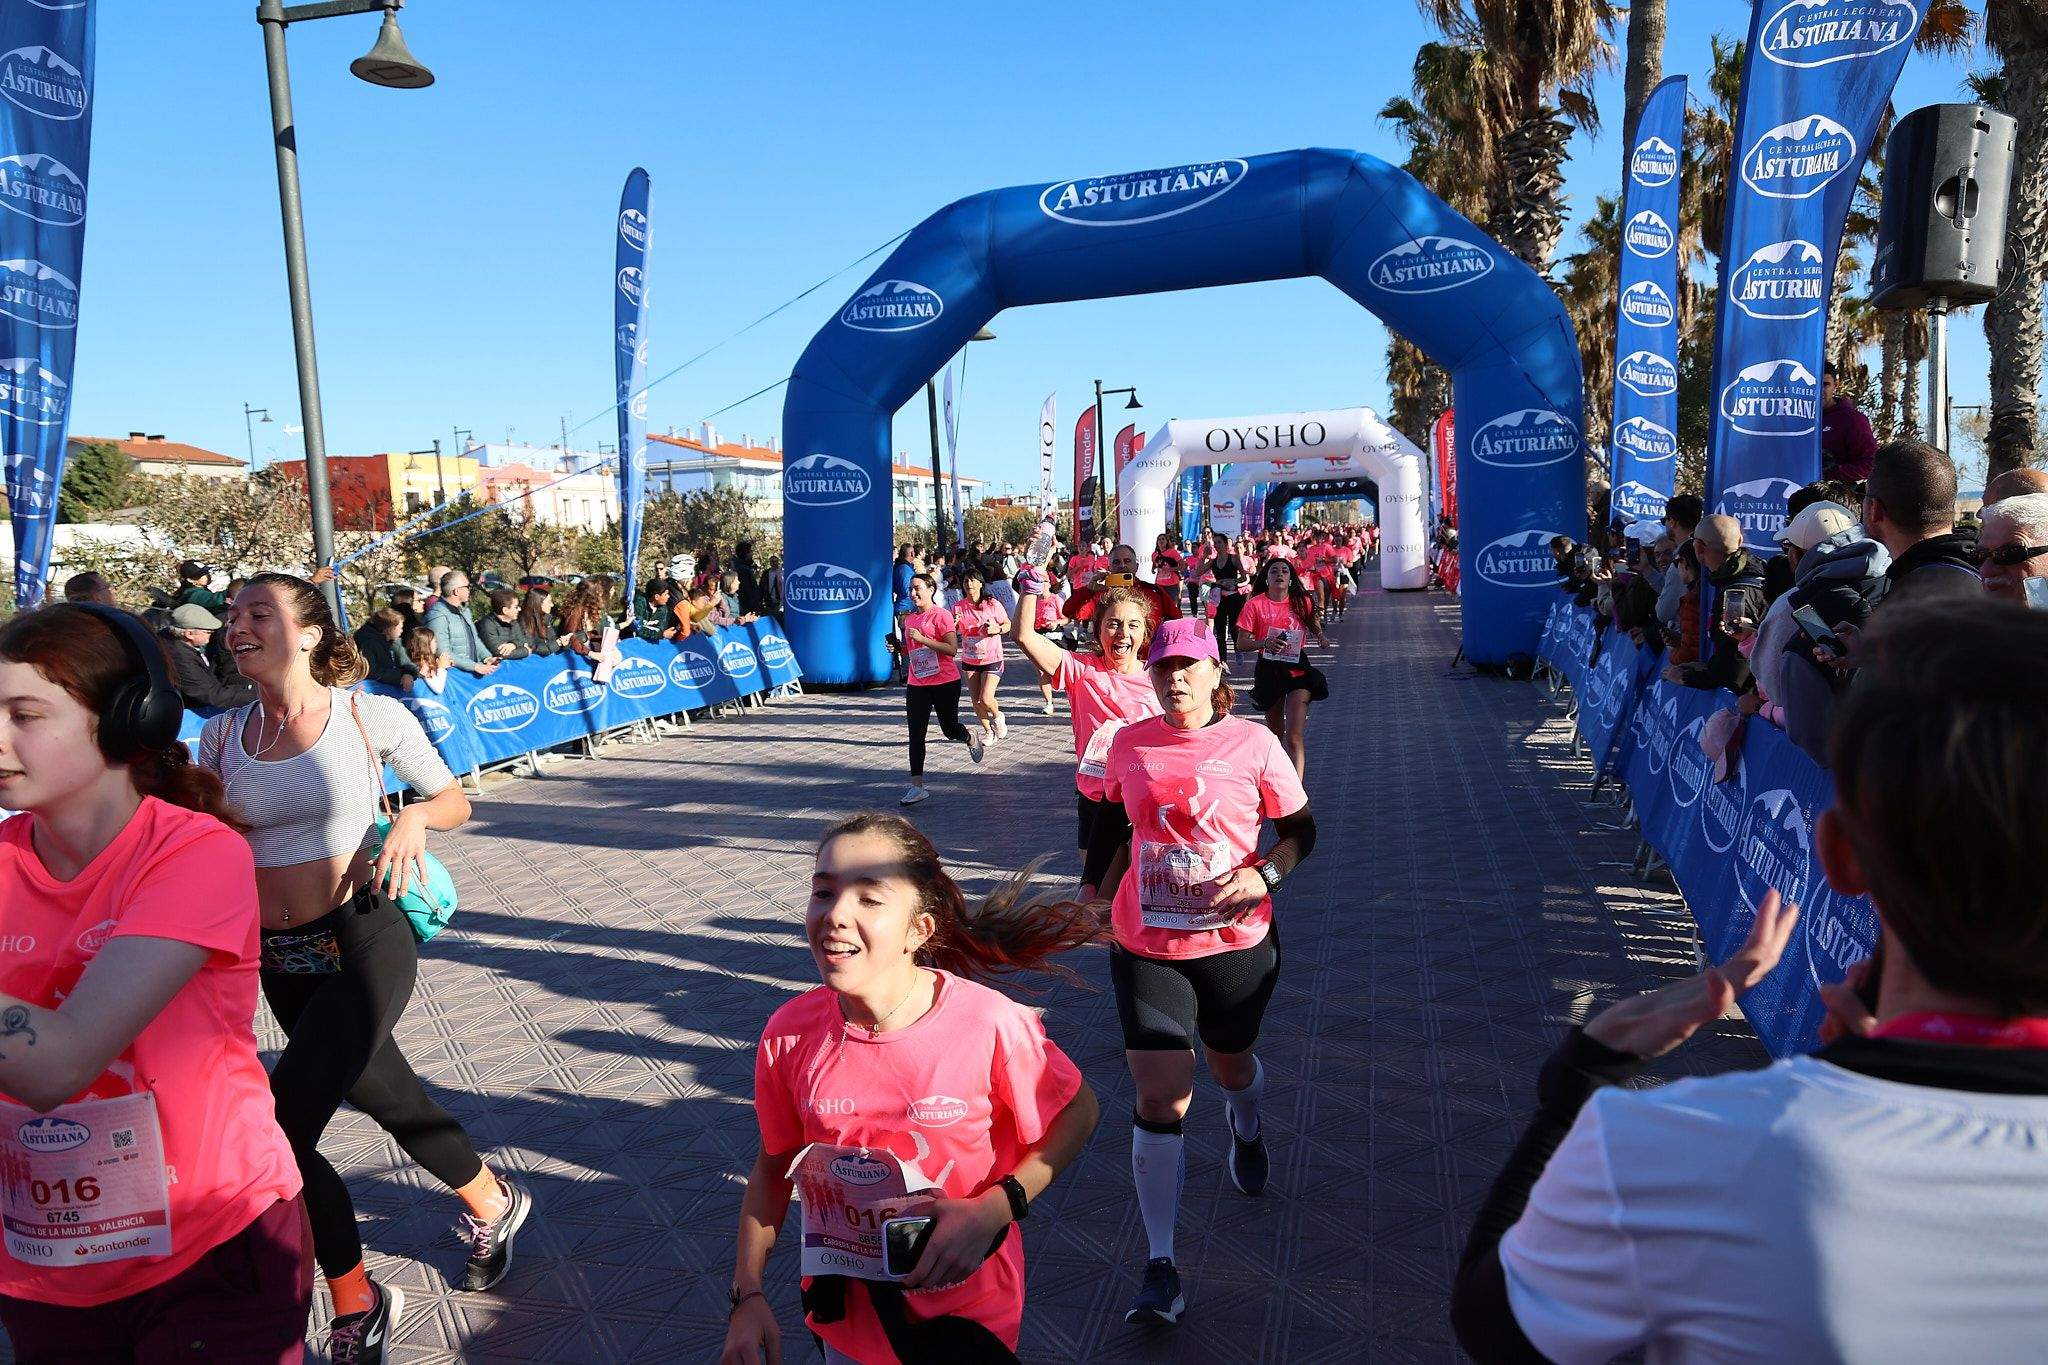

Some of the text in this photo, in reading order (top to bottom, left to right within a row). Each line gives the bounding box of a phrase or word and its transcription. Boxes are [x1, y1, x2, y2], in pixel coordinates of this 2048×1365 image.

[1798, 7, 1902, 23] CENTRAL LECHERA
[1769, 18, 1899, 51] ASTURIANA
[1, 62, 83, 109] ASTURIANA
[1769, 143, 1815, 155] CENTRAL
[1752, 149, 1840, 181] ASTURIANA
[0, 168, 83, 216] ASTURIANA
[1053, 166, 1231, 211] ASTURIANA
[1627, 225, 1668, 249] ASTURIANA
[1379, 257, 1487, 285] ASTURIANA
[1752, 267, 1800, 277] CENTRAL
[846, 302, 935, 321] ASTURIANA
[1625, 294, 1671, 318] ASTURIANA
[1740, 386, 1793, 395] CENTRAL
[1205, 421, 1327, 453] OYSHO
[1478, 433, 1575, 456] ASTURIANA
[1362, 443, 1401, 453] OYSHO
[1446, 426, 1457, 484] Santander
[1136, 460, 1172, 468] OYSHO
[786, 475, 865, 494] ASTURIANA
[1297, 481, 1358, 491] VOLVO
[1733, 501, 1783, 511] CENTRAL
[1482, 552, 1559, 574] ASTURIA
[787, 582, 866, 601] ASTURIANA
[615, 673, 665, 692] ASTURIANA
[673, 665, 714, 682] ASTURIANA
[549, 683, 603, 709] ASTURIANA
[473, 701, 535, 727] ASTURIANA
[1128, 762, 1168, 772] OYSHO
[1738, 813, 1799, 904] ASTURIANA
[1168, 882, 1204, 898] 016
[912, 1107, 965, 1120] ASTURIANA
[22, 1130, 85, 1145] ASTURIANA
[835, 1162, 887, 1179] ASTURIANA
[31, 1176, 101, 1206] 016
[46, 1211, 80, 1223] 6745
[49, 1228, 60, 1237] LA
[61, 1225, 92, 1236] MUJER
[100, 1216, 146, 1232] VALENCIA
[14, 1236, 152, 1258] OYSHO Santander
[823, 1237, 850, 1250] CARRERA
[820, 1252, 865, 1270] OYSHO
